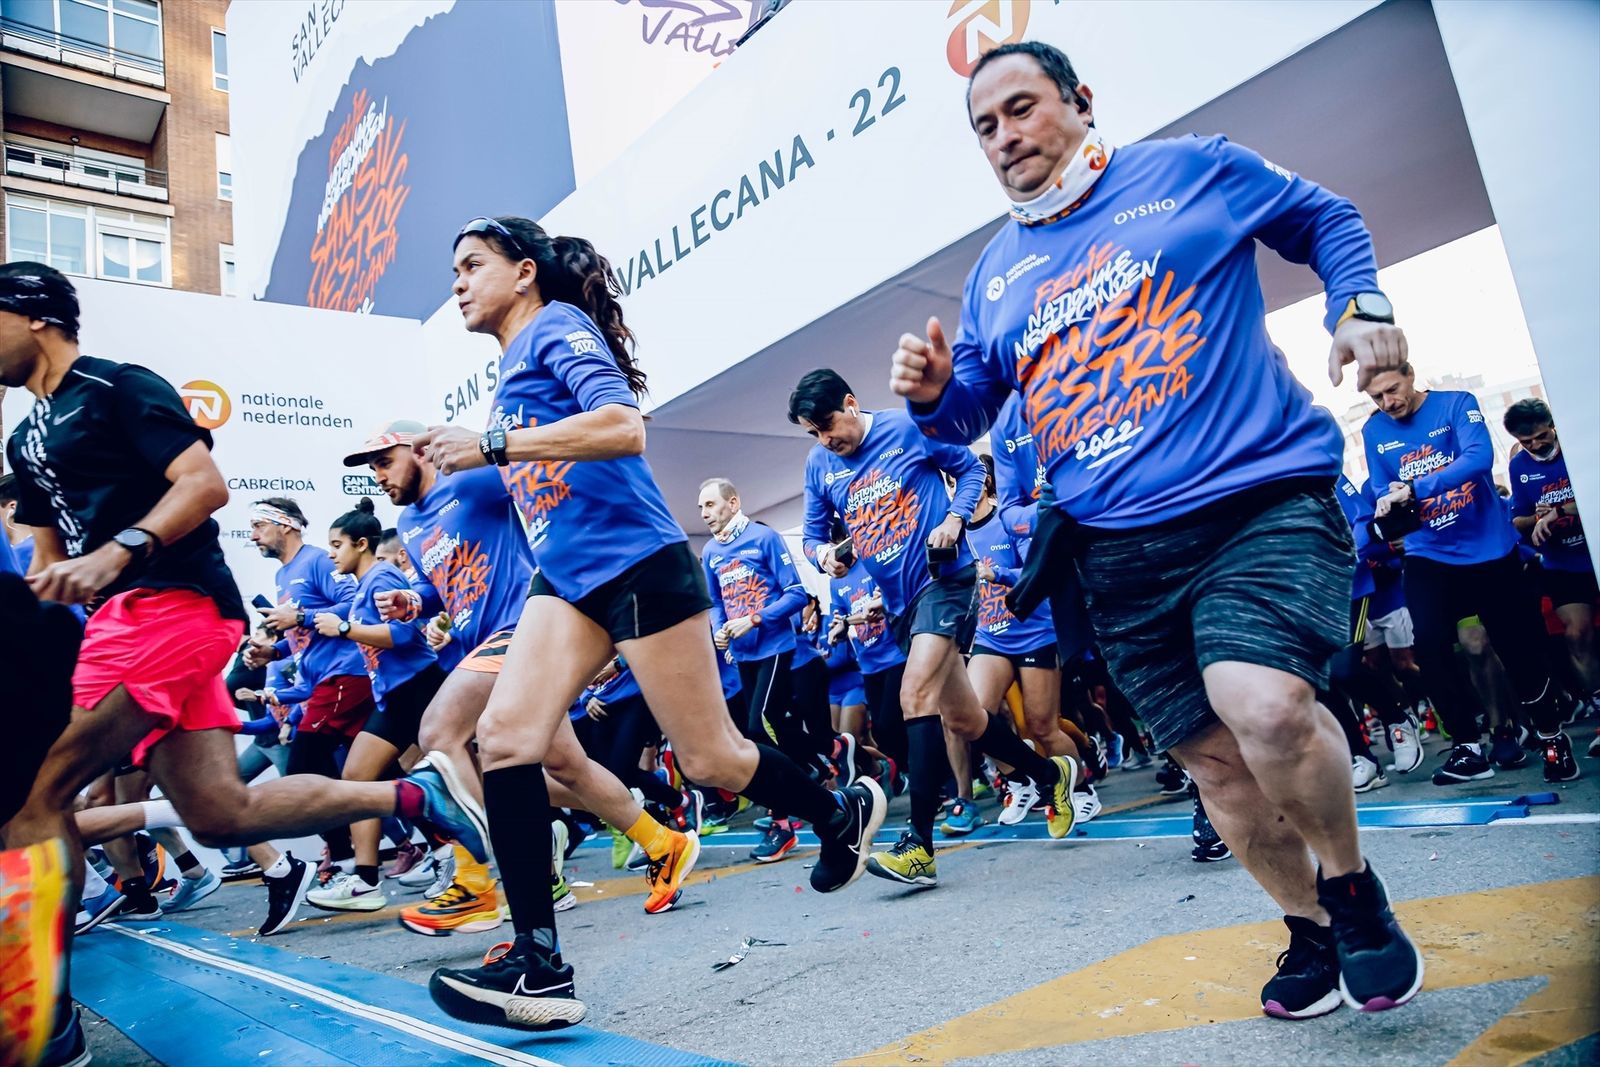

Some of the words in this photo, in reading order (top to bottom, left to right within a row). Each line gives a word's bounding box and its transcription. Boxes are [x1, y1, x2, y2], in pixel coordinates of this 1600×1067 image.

[292, 2, 316, 61] SAN
[616, 134, 815, 297] VALLECANA
[847, 66, 907, 137] 22
[1113, 198, 1176, 226] OYSHO
[241, 392, 324, 409] nationale
[444, 374, 479, 423] SAN
[243, 410, 353, 428] nederlanden
[1075, 420, 1144, 461] 2022
[879, 447, 904, 461] OYSHO
[344, 476, 369, 486] SANI
[344, 486, 387, 495] CENTRO
[1429, 512, 1459, 528] 2022
[875, 543, 904, 563] 2022
